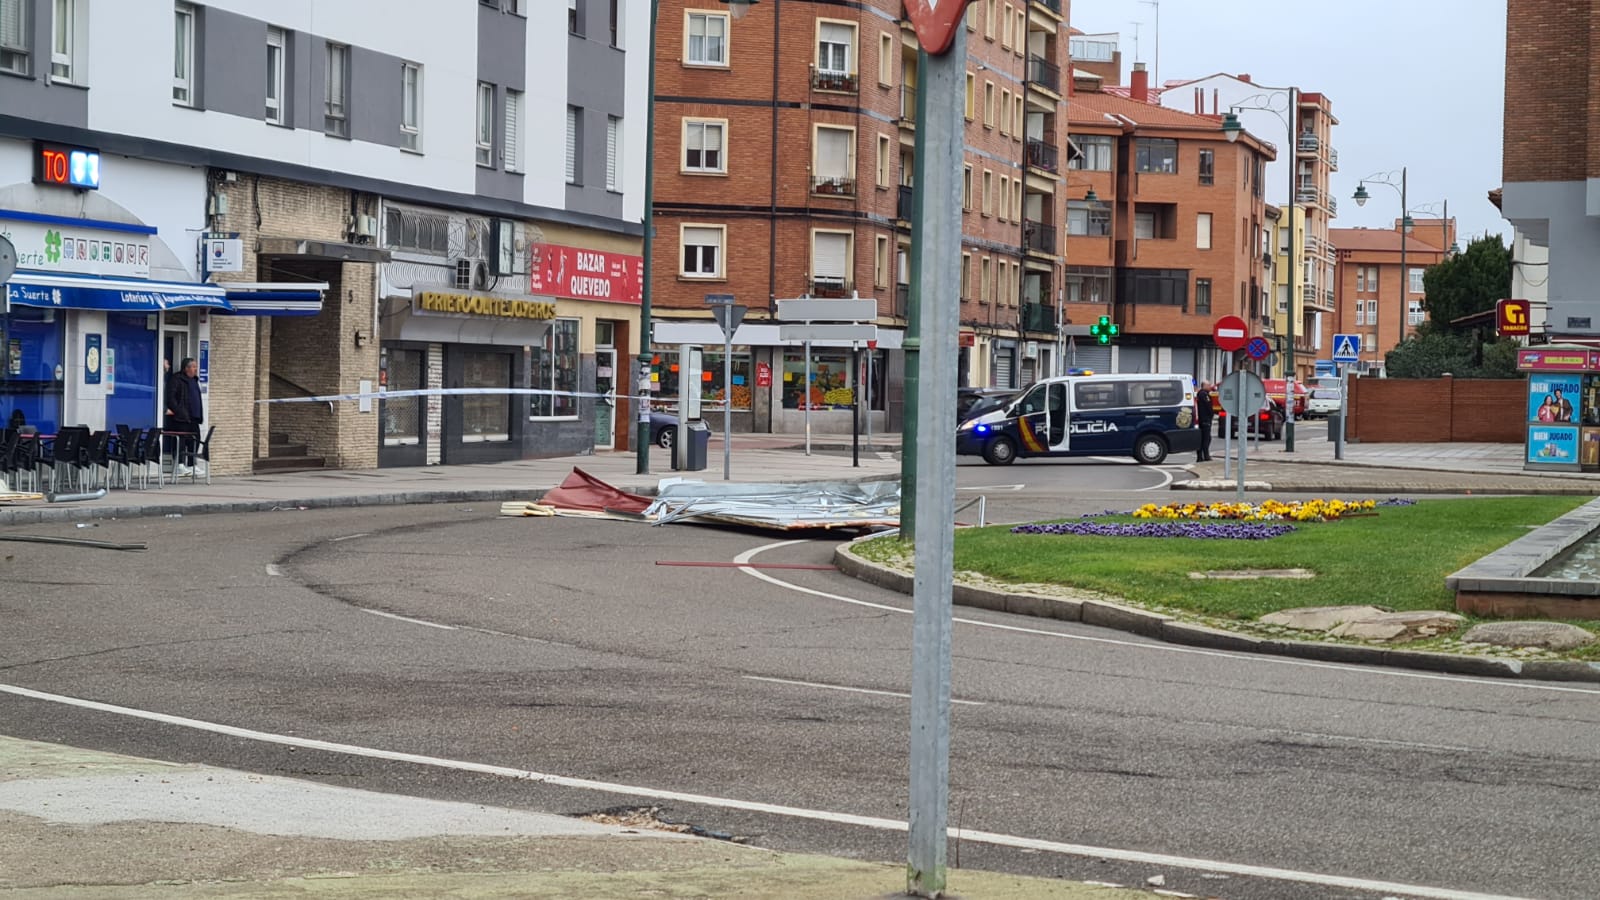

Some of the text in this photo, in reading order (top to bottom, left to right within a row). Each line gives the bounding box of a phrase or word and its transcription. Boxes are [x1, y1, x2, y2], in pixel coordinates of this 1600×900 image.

[43, 150, 68, 183] TO
[577, 251, 605, 273] BAZAR
[22, 286, 50, 301] Suerte
[570, 275, 610, 297] QUEVEDO
[1531, 383, 1580, 394] BIEN JUGADO
[1549, 433, 1573, 441] JUGADO
